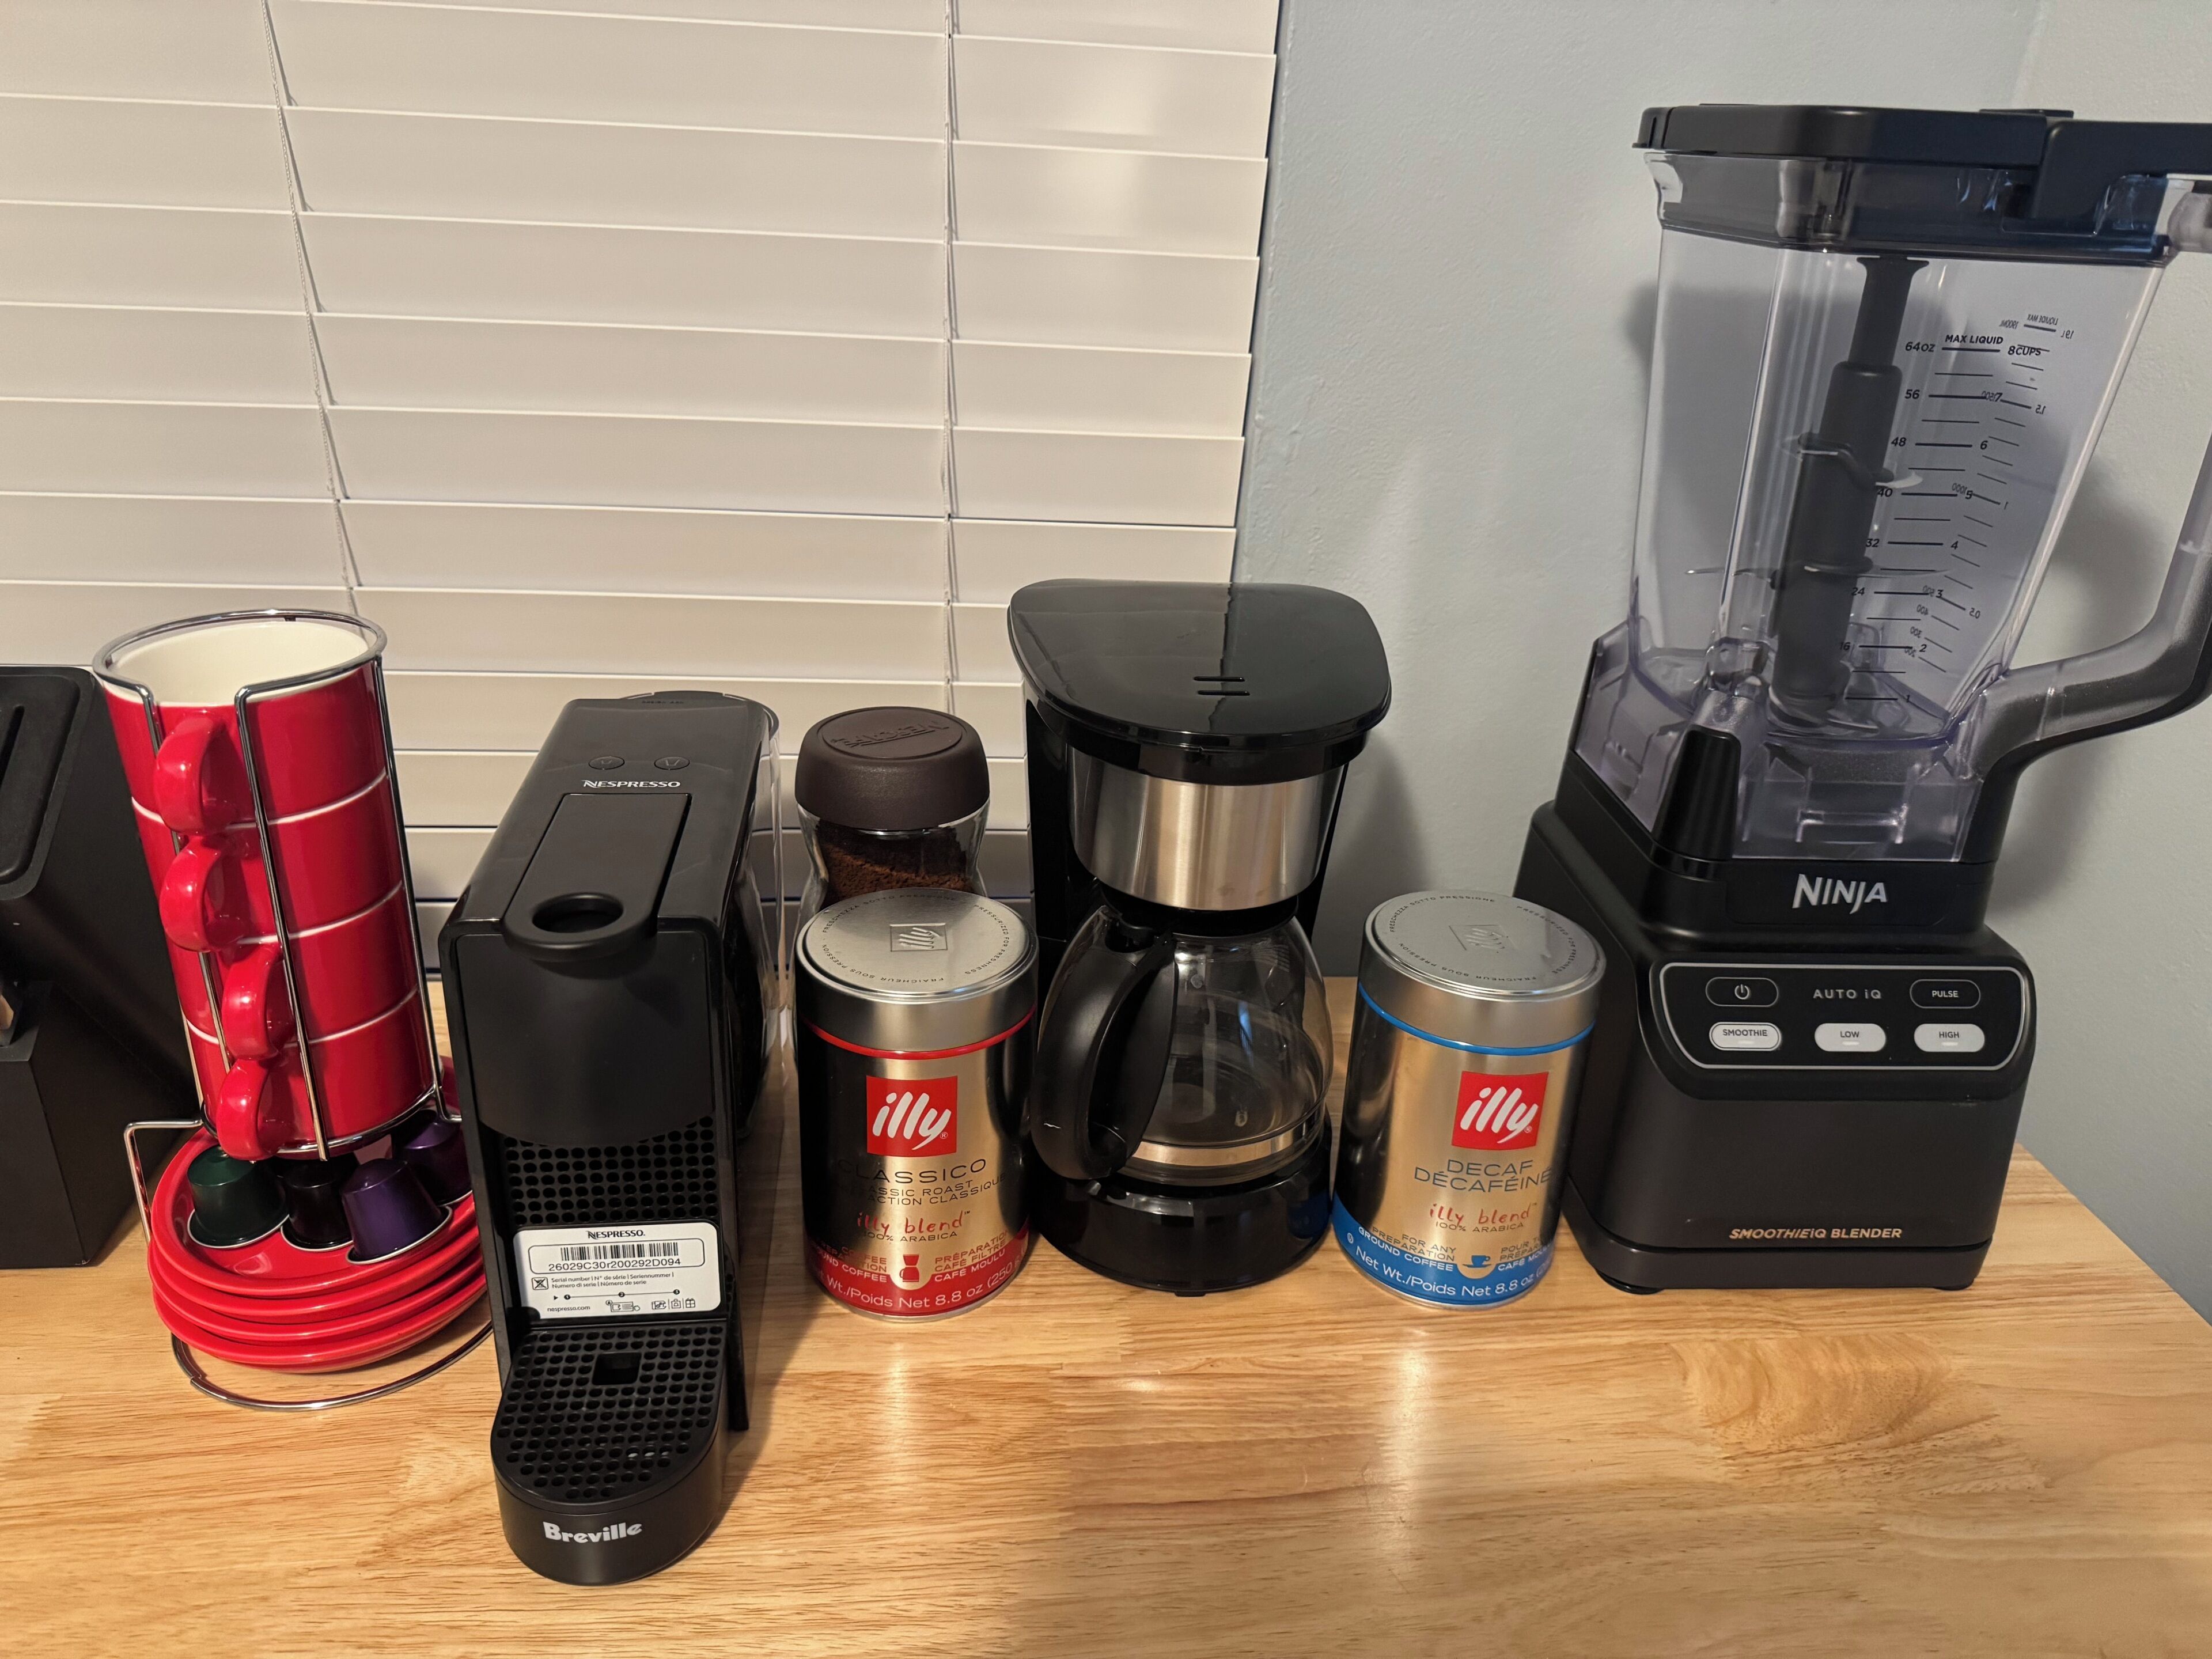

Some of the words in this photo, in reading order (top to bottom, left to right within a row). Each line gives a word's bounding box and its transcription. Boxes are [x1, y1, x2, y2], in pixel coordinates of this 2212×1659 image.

[1945, 334, 1967, 343] MAX
[1969, 335, 2003, 345] LIQUID
[1904, 389, 1920, 399] 56
[1995, 392, 2003, 402] 7
[1891, 437, 1907, 446] 48
[1980, 440, 1988, 450] 6
[1877, 488, 1893, 497] 40
[1965, 490, 1974, 499] 5
[1865, 539, 1880, 548] 32
[1950, 540, 1959, 550] 4
[1851, 587, 1865, 596] 24
[1936, 589, 1944, 598] 3
[1839, 641, 1851, 650] 16
[1919, 644, 1927, 653] 2
[581, 779, 680, 789] NESPRESSO
[1792, 873, 1888, 914] NINJA
[822, 904, 860, 933] FRESCHEZZA
[863, 896, 895, 904] SOTTO
[973, 904, 1009, 935] PRESSURIZED
[1389, 905, 1409, 933] FRESCHEZZA
[1410, 896, 1437, 906] SOTTO
[821, 944, 848, 968] PRESSION
[964, 949, 1006, 975] FRESHNESS
[850, 968, 876, 979] SOUS
[1813, 989, 1858, 999] AUTO
[1864, 989, 1883, 999] iQ
[1931, 990, 1959, 998] PULSE
[1722, 1029, 1767, 1037] SMOOTHIE
[1939, 1031, 1960, 1039] HIGH
[839, 1158, 986, 1184] CLASSICO
[1446, 1159, 1534, 1177] DECAF
[1414, 1166, 1553, 1193] DÉCAFÉINÉ
[864, 1185, 915, 1197] ASSIC
[922, 1180, 973, 1196] ROAST
[929, 1172, 1007, 1205] CLASSIQUE
[1430, 1203, 1464, 1227] illy
[857, 1211, 890, 1237] illy
[1436, 1221, 1467, 1232] 100%
[1472, 1221, 1524, 1233] ARABICA
[900, 1230, 958, 1242] ARABICA
[1830, 1228, 1903, 1238] BLENDER
[1358, 1226, 1400, 1256] GROUND
[1404, 1253, 1455, 1272] COFFEE
[1372, 1226, 1455, 1262] PREPARATION
[1402, 1233, 1426, 1248] FOR
[1430, 1244, 1457, 1254] ANY
[1501, 1241, 1530, 1254] POUR
[935, 1259, 967, 1272] CAFÉ
[971, 1238, 1006, 1263] FILTRE
[934, 1268, 967, 1282] CAFÉ
[971, 1248, 1006, 1273] MOULU
[1356, 1245, 1379, 1271] Net
[1382, 1263, 1457, 1296] Wt./Poids
[1461, 1285, 1492, 1297] Net
[1495, 1279, 1519, 1294] 8.8
[1520, 1273, 1536, 1286] oz
[842, 1264, 888, 1283] COFFEE
[827, 1274, 893, 1307] Wt./Poids
[899, 1297, 930, 1308] Net
[935, 1290, 962, 1306] 8.8
[966, 1284, 984, 1297] oz
[543, 1521, 643, 1543] Breville
